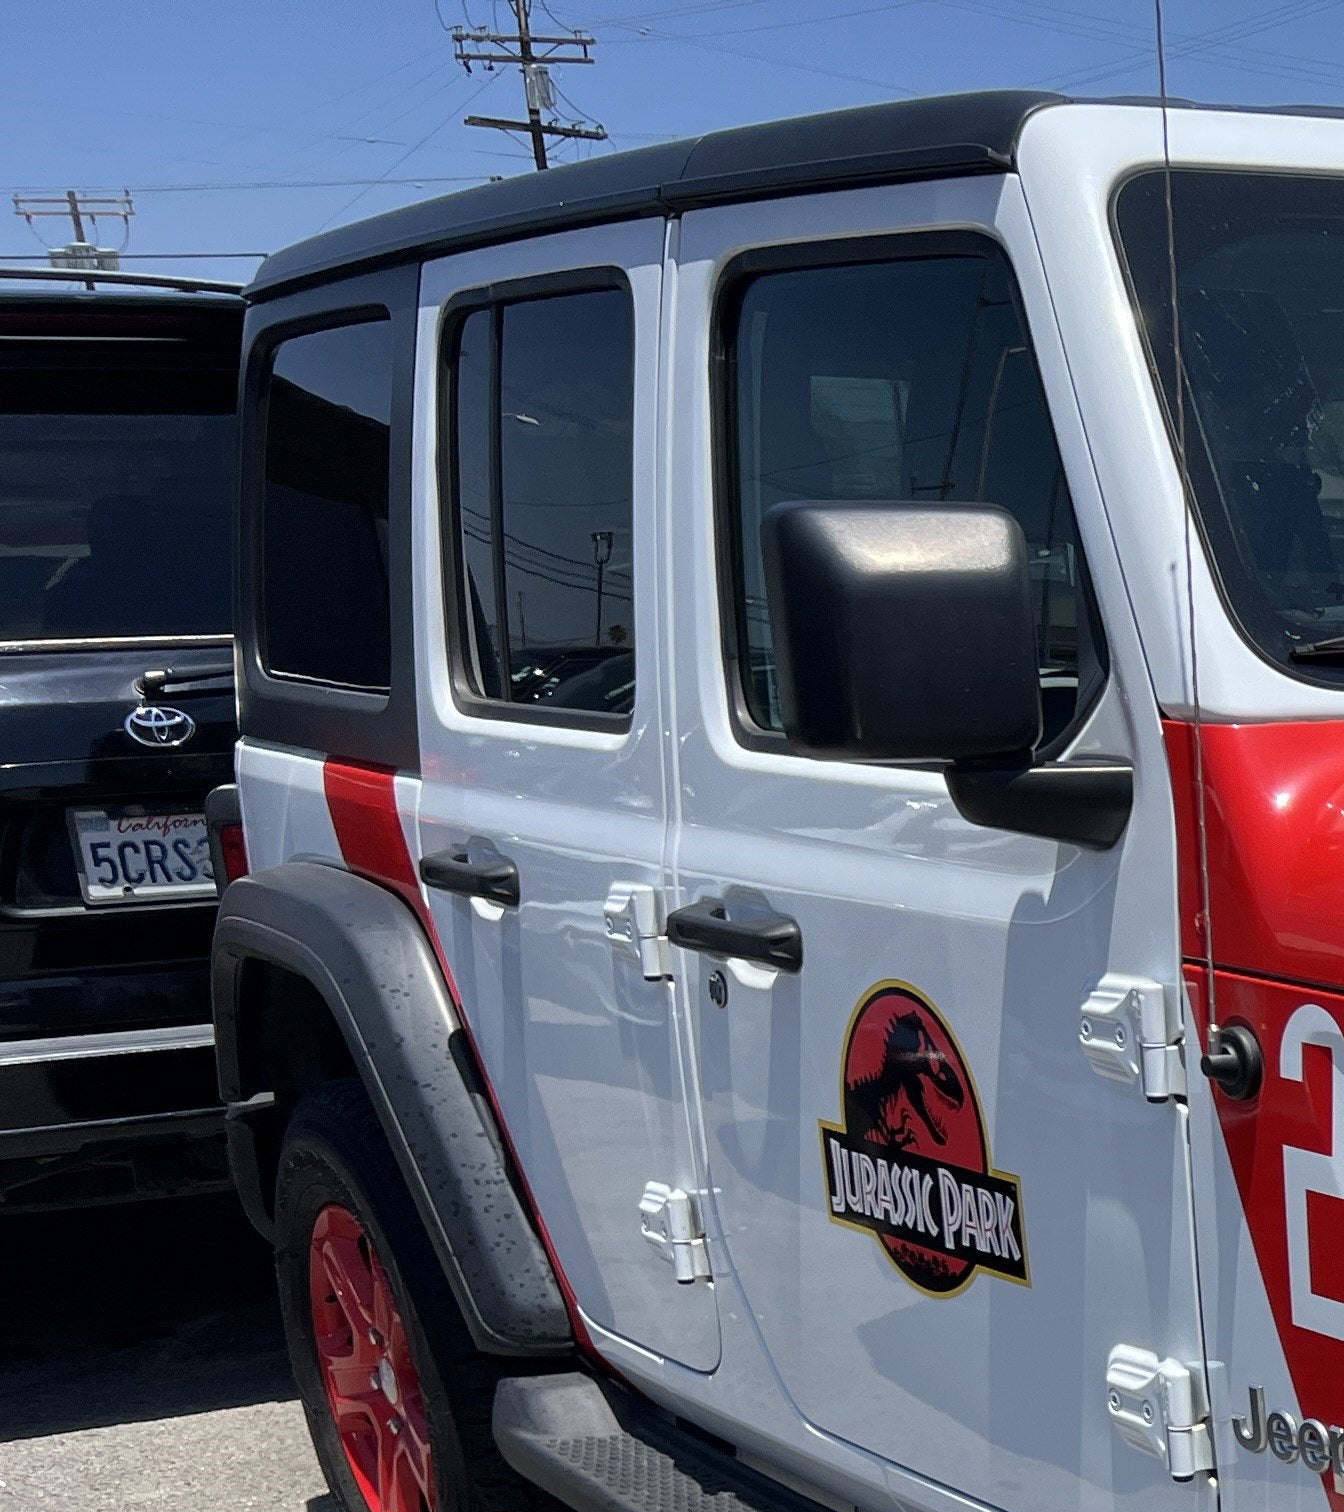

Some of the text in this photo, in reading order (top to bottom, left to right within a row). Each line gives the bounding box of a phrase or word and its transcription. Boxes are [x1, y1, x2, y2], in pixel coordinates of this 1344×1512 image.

[117, 815, 209, 838] Californ
[829, 1137, 1021, 1262] JURASSIC PARK
